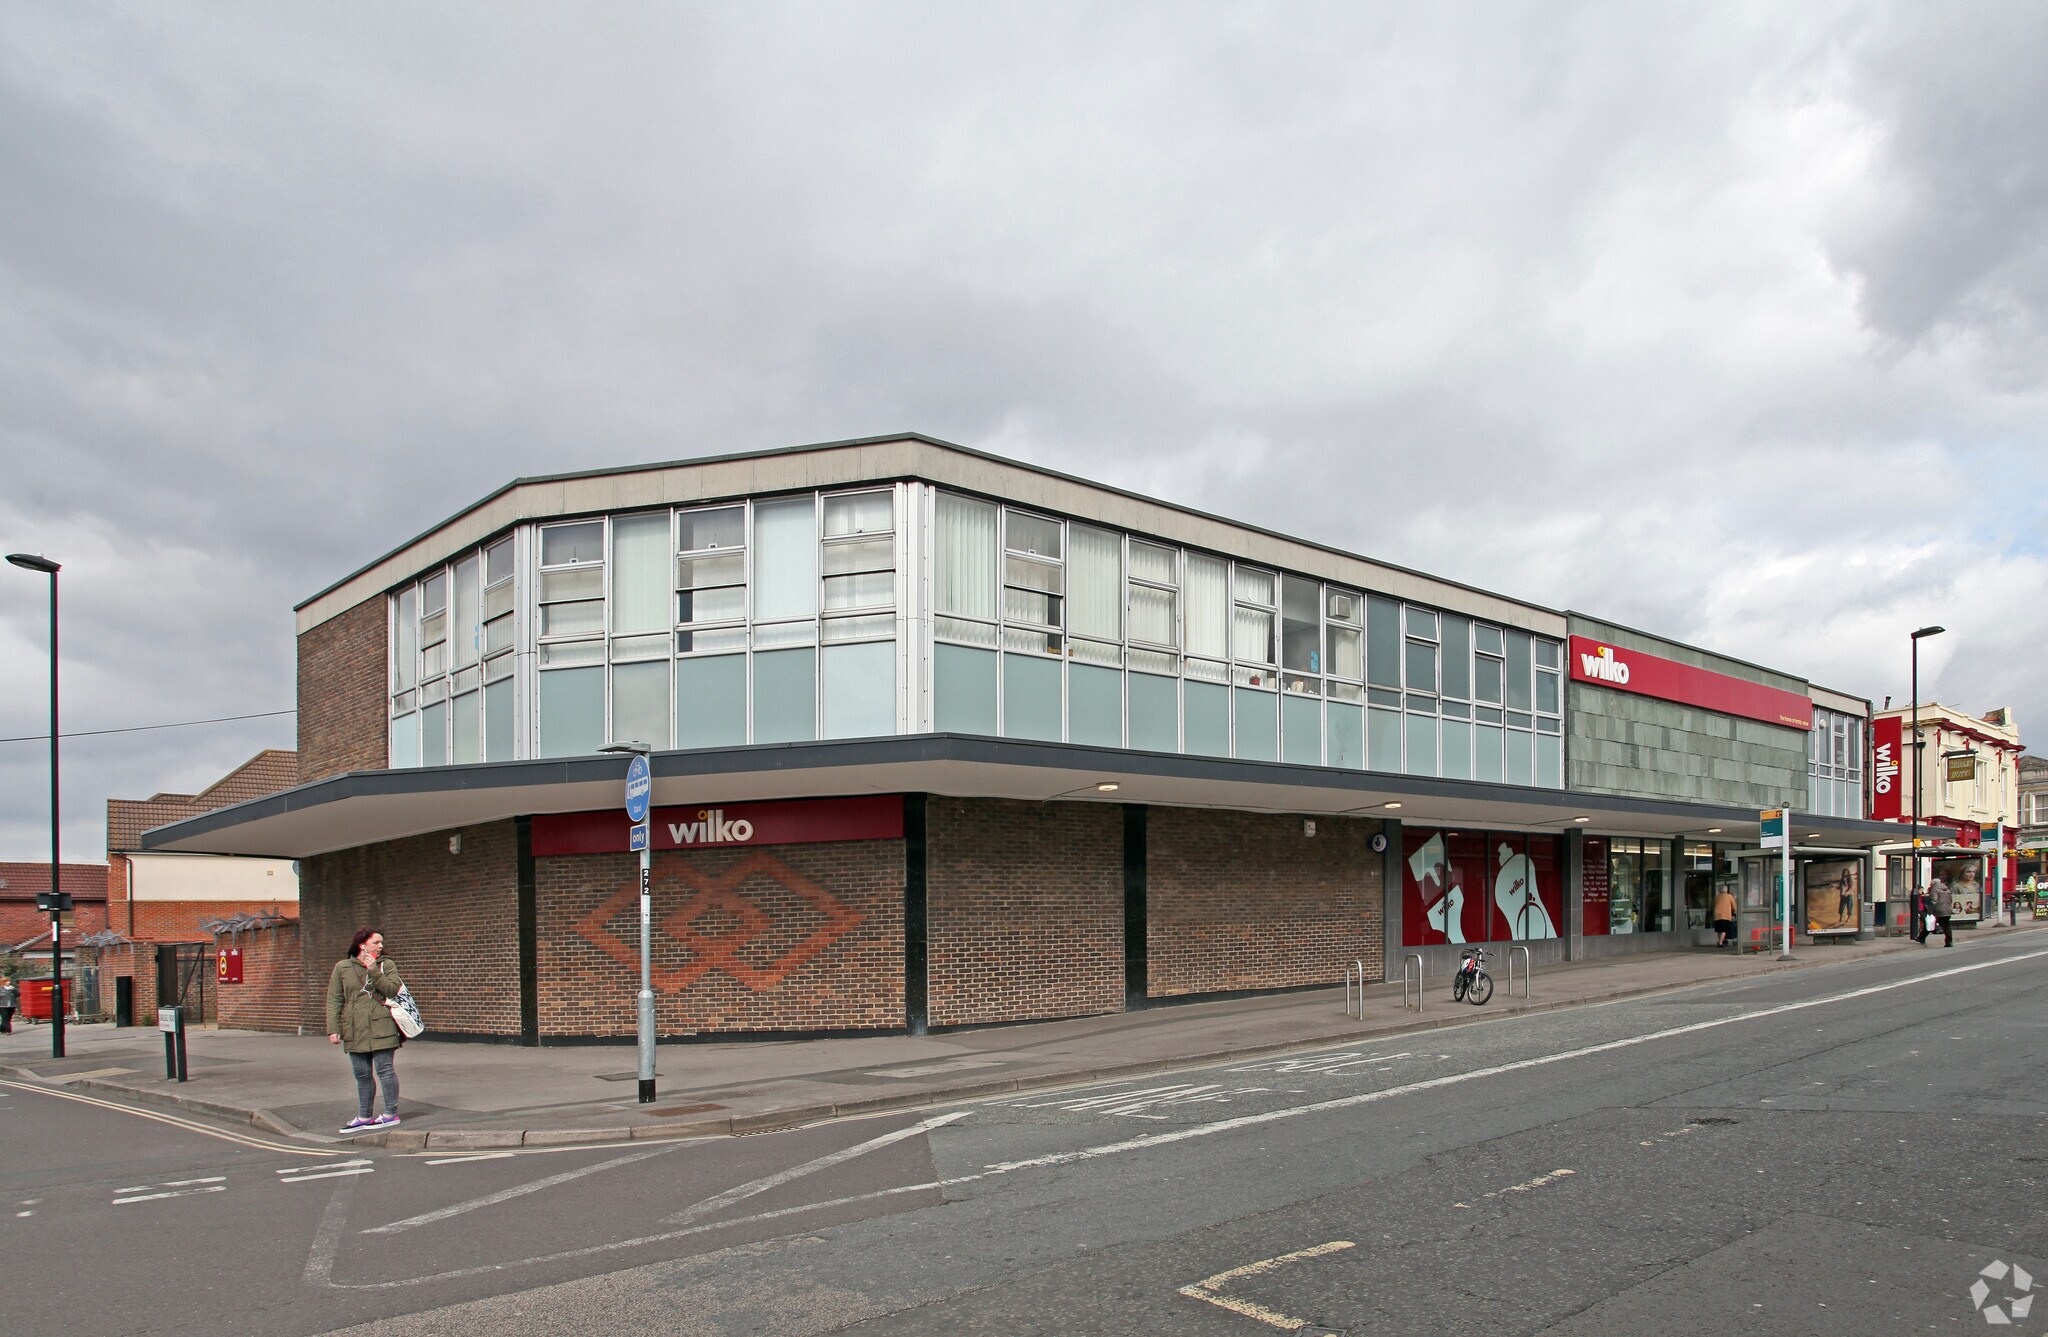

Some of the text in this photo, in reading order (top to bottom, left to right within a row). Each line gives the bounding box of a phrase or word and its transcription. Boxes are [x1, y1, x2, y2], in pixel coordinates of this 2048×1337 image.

[1581, 646, 1630, 684] wilko
[1876, 742, 1898, 794] wilko
[633, 830, 644, 843] only
[668, 810, 753, 844] wilko
[1508, 878, 1524, 896] wilko
